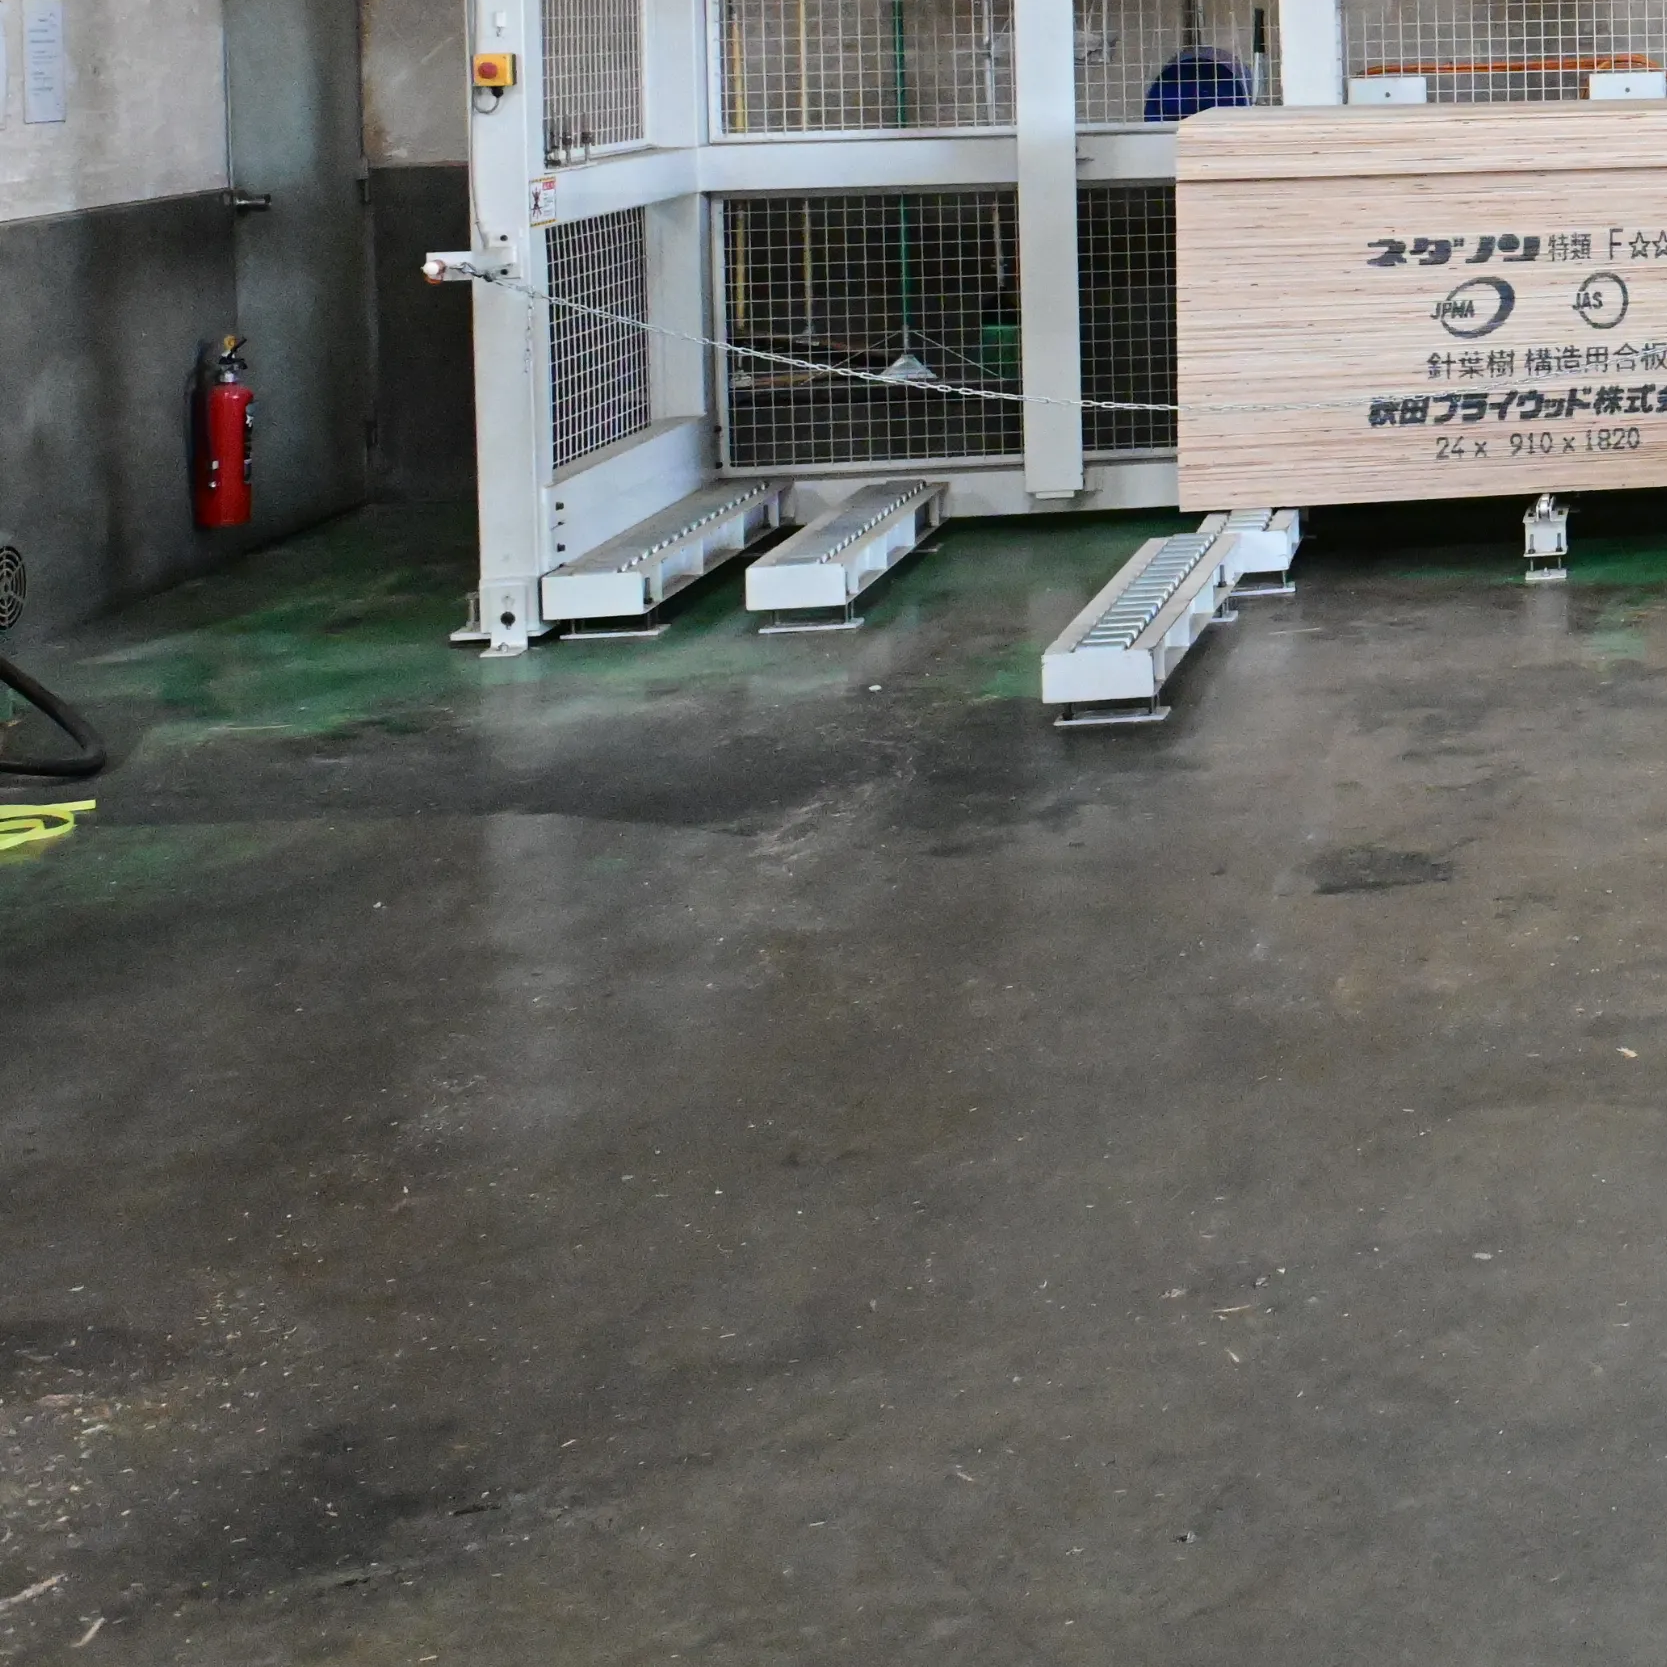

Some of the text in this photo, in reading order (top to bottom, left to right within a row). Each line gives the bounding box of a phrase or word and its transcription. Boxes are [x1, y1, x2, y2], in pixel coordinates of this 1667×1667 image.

[1366, 233, 1541, 267] ネダノン
[1548, 233, 1593, 262] 特類
[1429, 299, 1476, 320] JPMA
[1572, 291, 1604, 311] JAS
[1435, 435, 1466, 460] 24
[1509, 431, 1553, 456] 910
[1584, 427, 1641, 452] 1820
